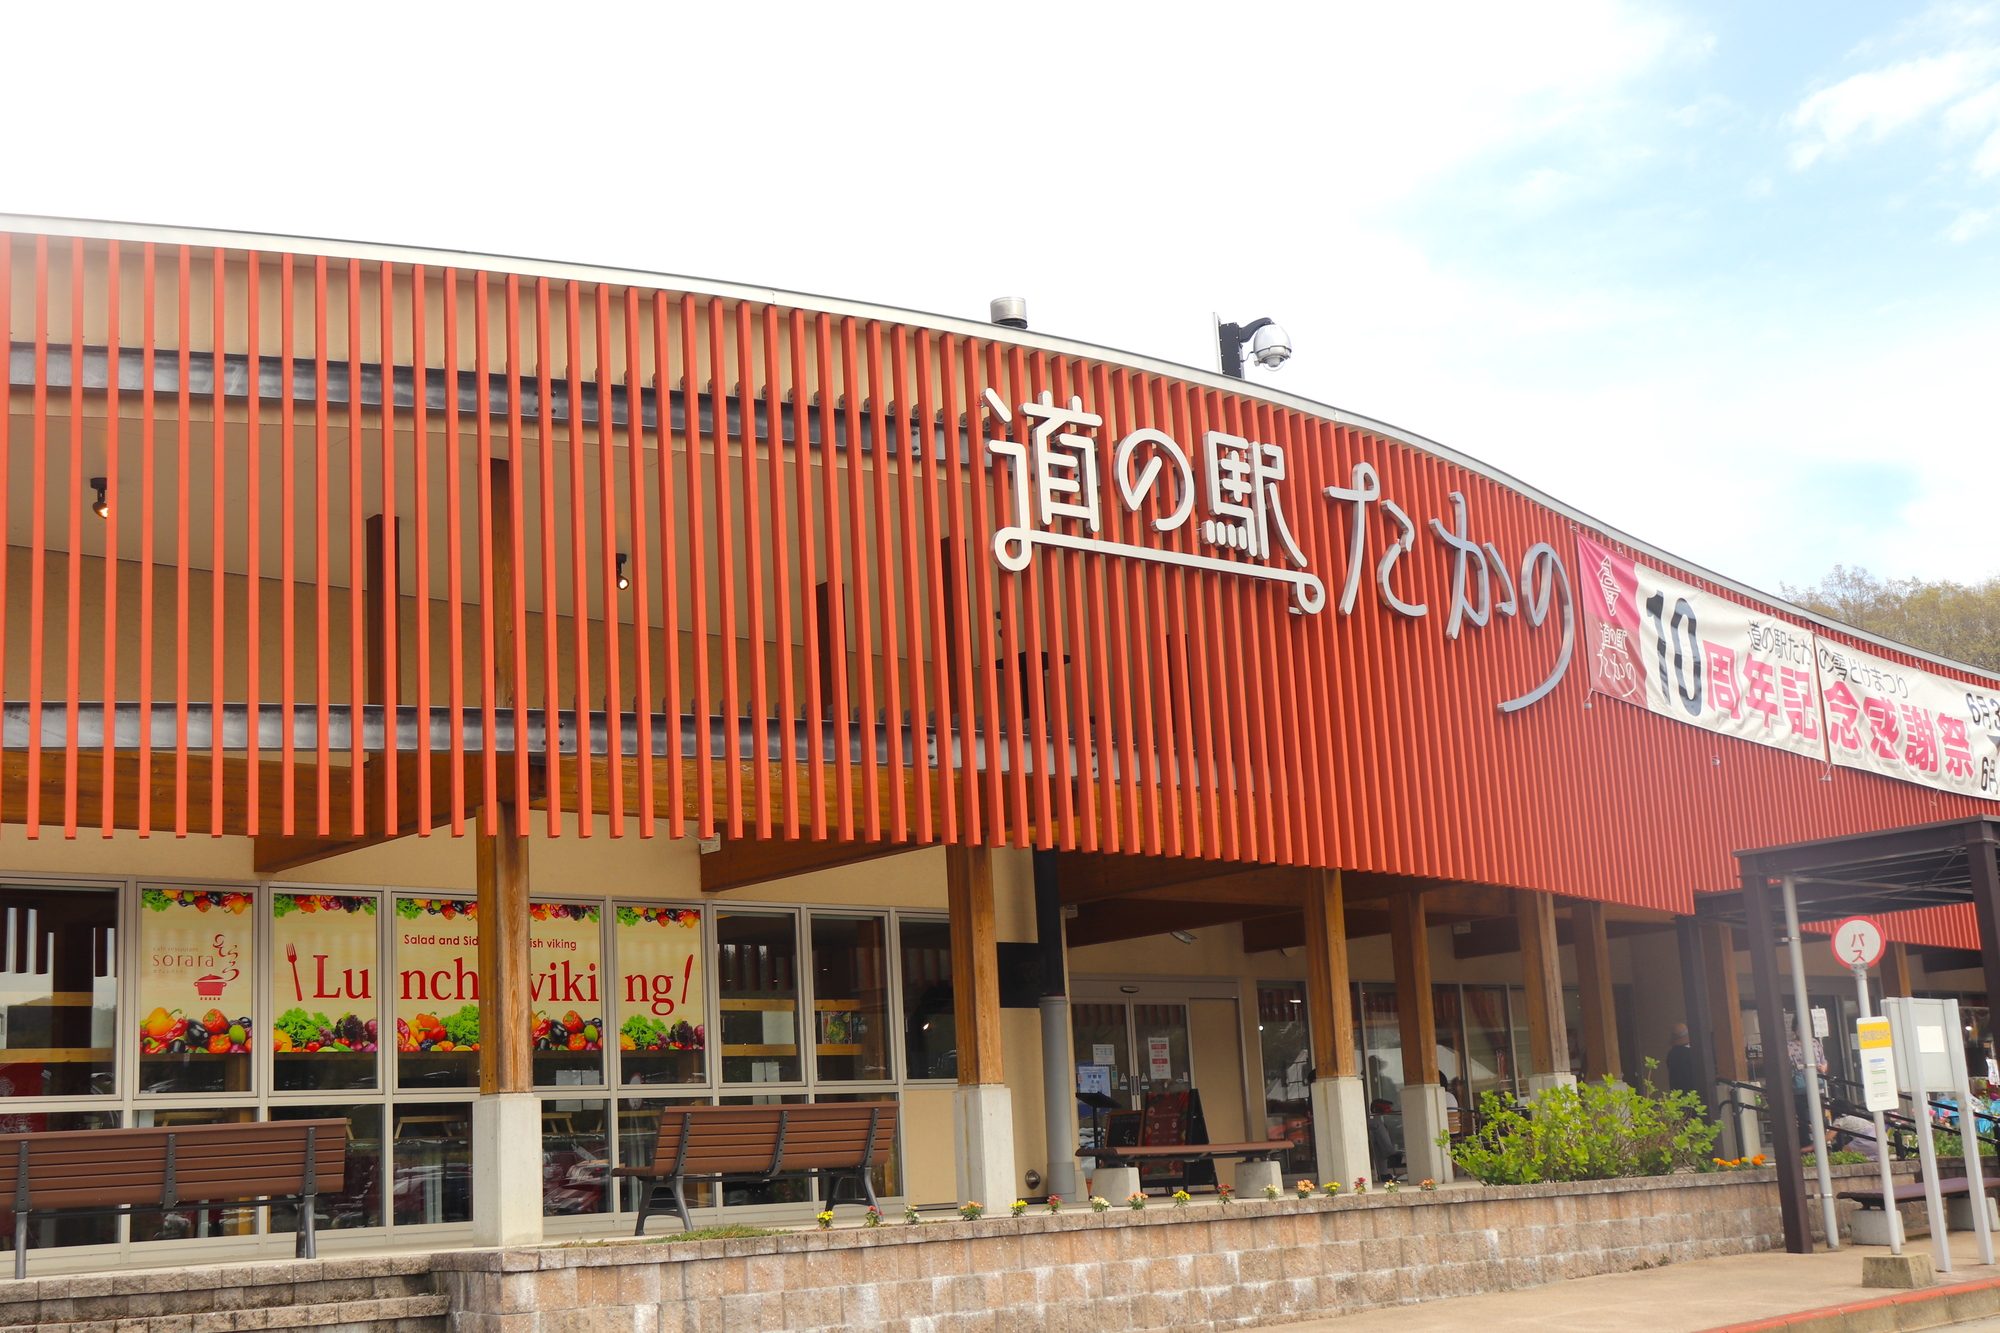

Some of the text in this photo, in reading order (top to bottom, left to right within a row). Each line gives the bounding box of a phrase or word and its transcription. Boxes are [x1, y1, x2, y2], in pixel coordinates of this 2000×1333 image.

[404, 934, 577, 951] Salad and Sid ish viking
[1851, 933, 1866, 963] バス
[152, 954, 214, 968] sorara
